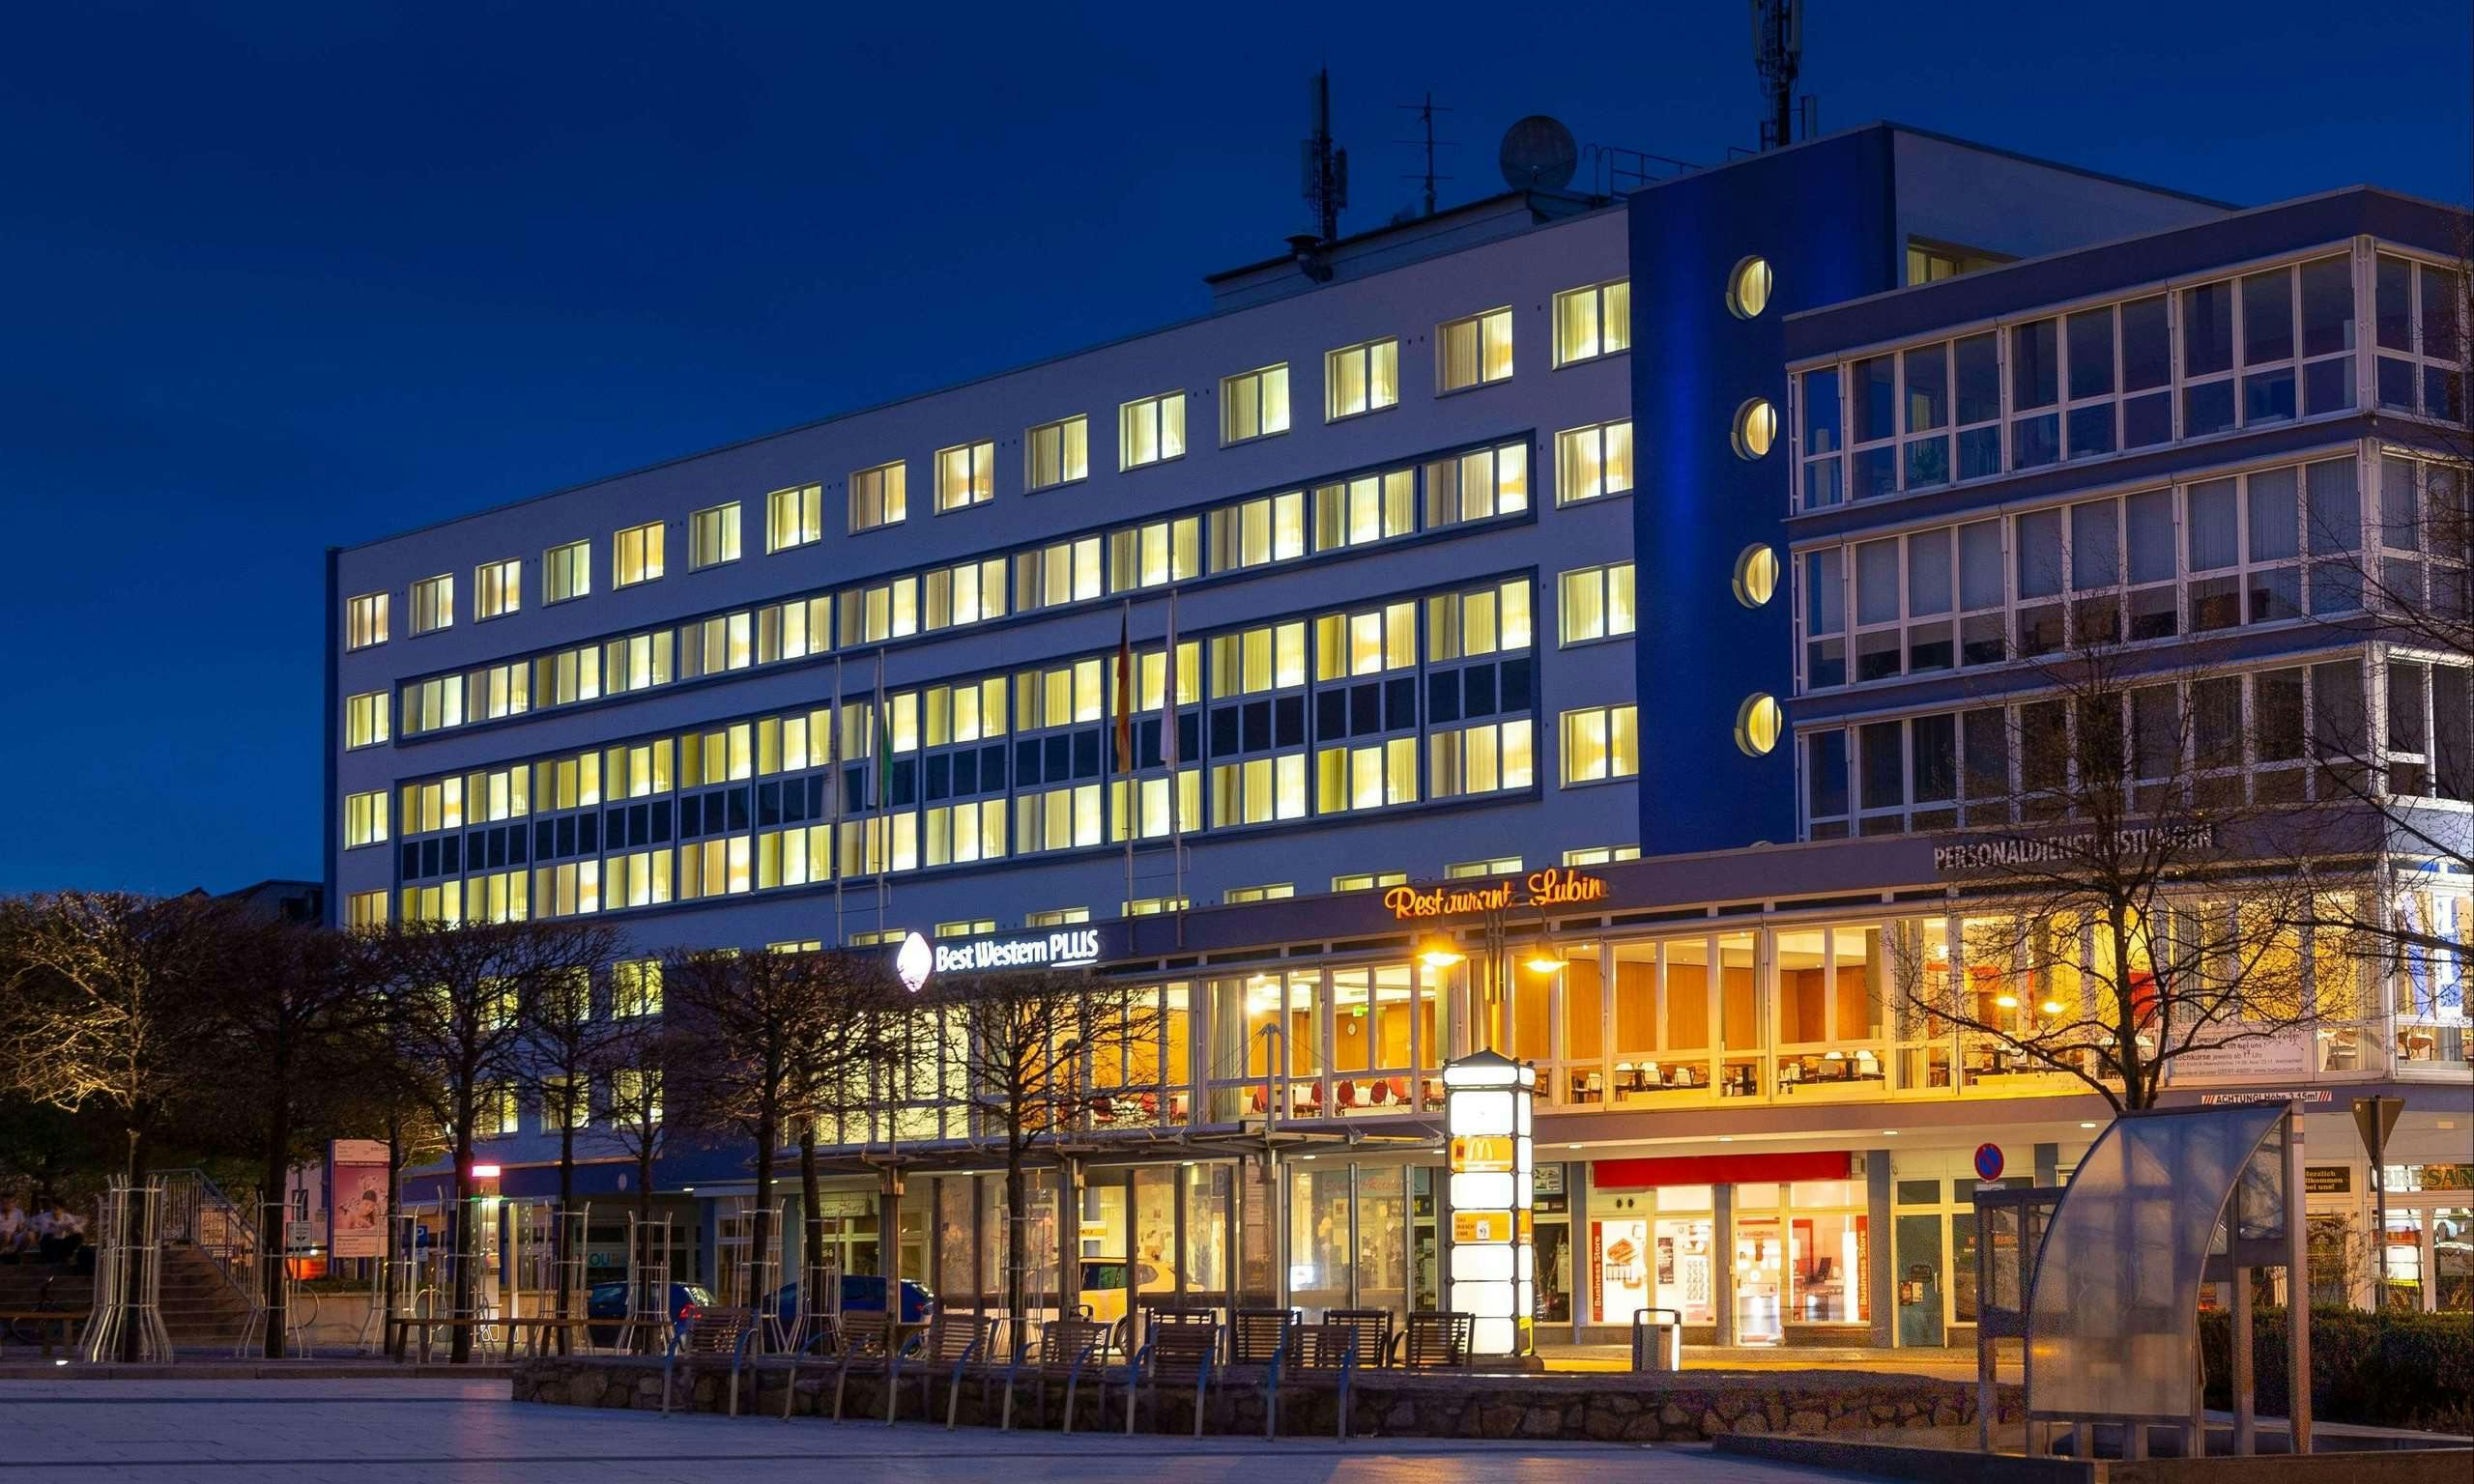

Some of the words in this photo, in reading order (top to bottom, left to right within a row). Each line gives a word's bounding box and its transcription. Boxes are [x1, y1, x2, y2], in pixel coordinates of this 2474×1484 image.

[1384, 880, 1513, 919] Restaurant
[1528, 868, 1602, 906] Lubin
[935, 946, 975, 972] Best
[975, 940, 1048, 967] Western
[1050, 929, 1098, 961] PLUS
[2216, 1093, 2261, 1103] ACHTUNG!
[1858, 1256, 1867, 1306] Business
